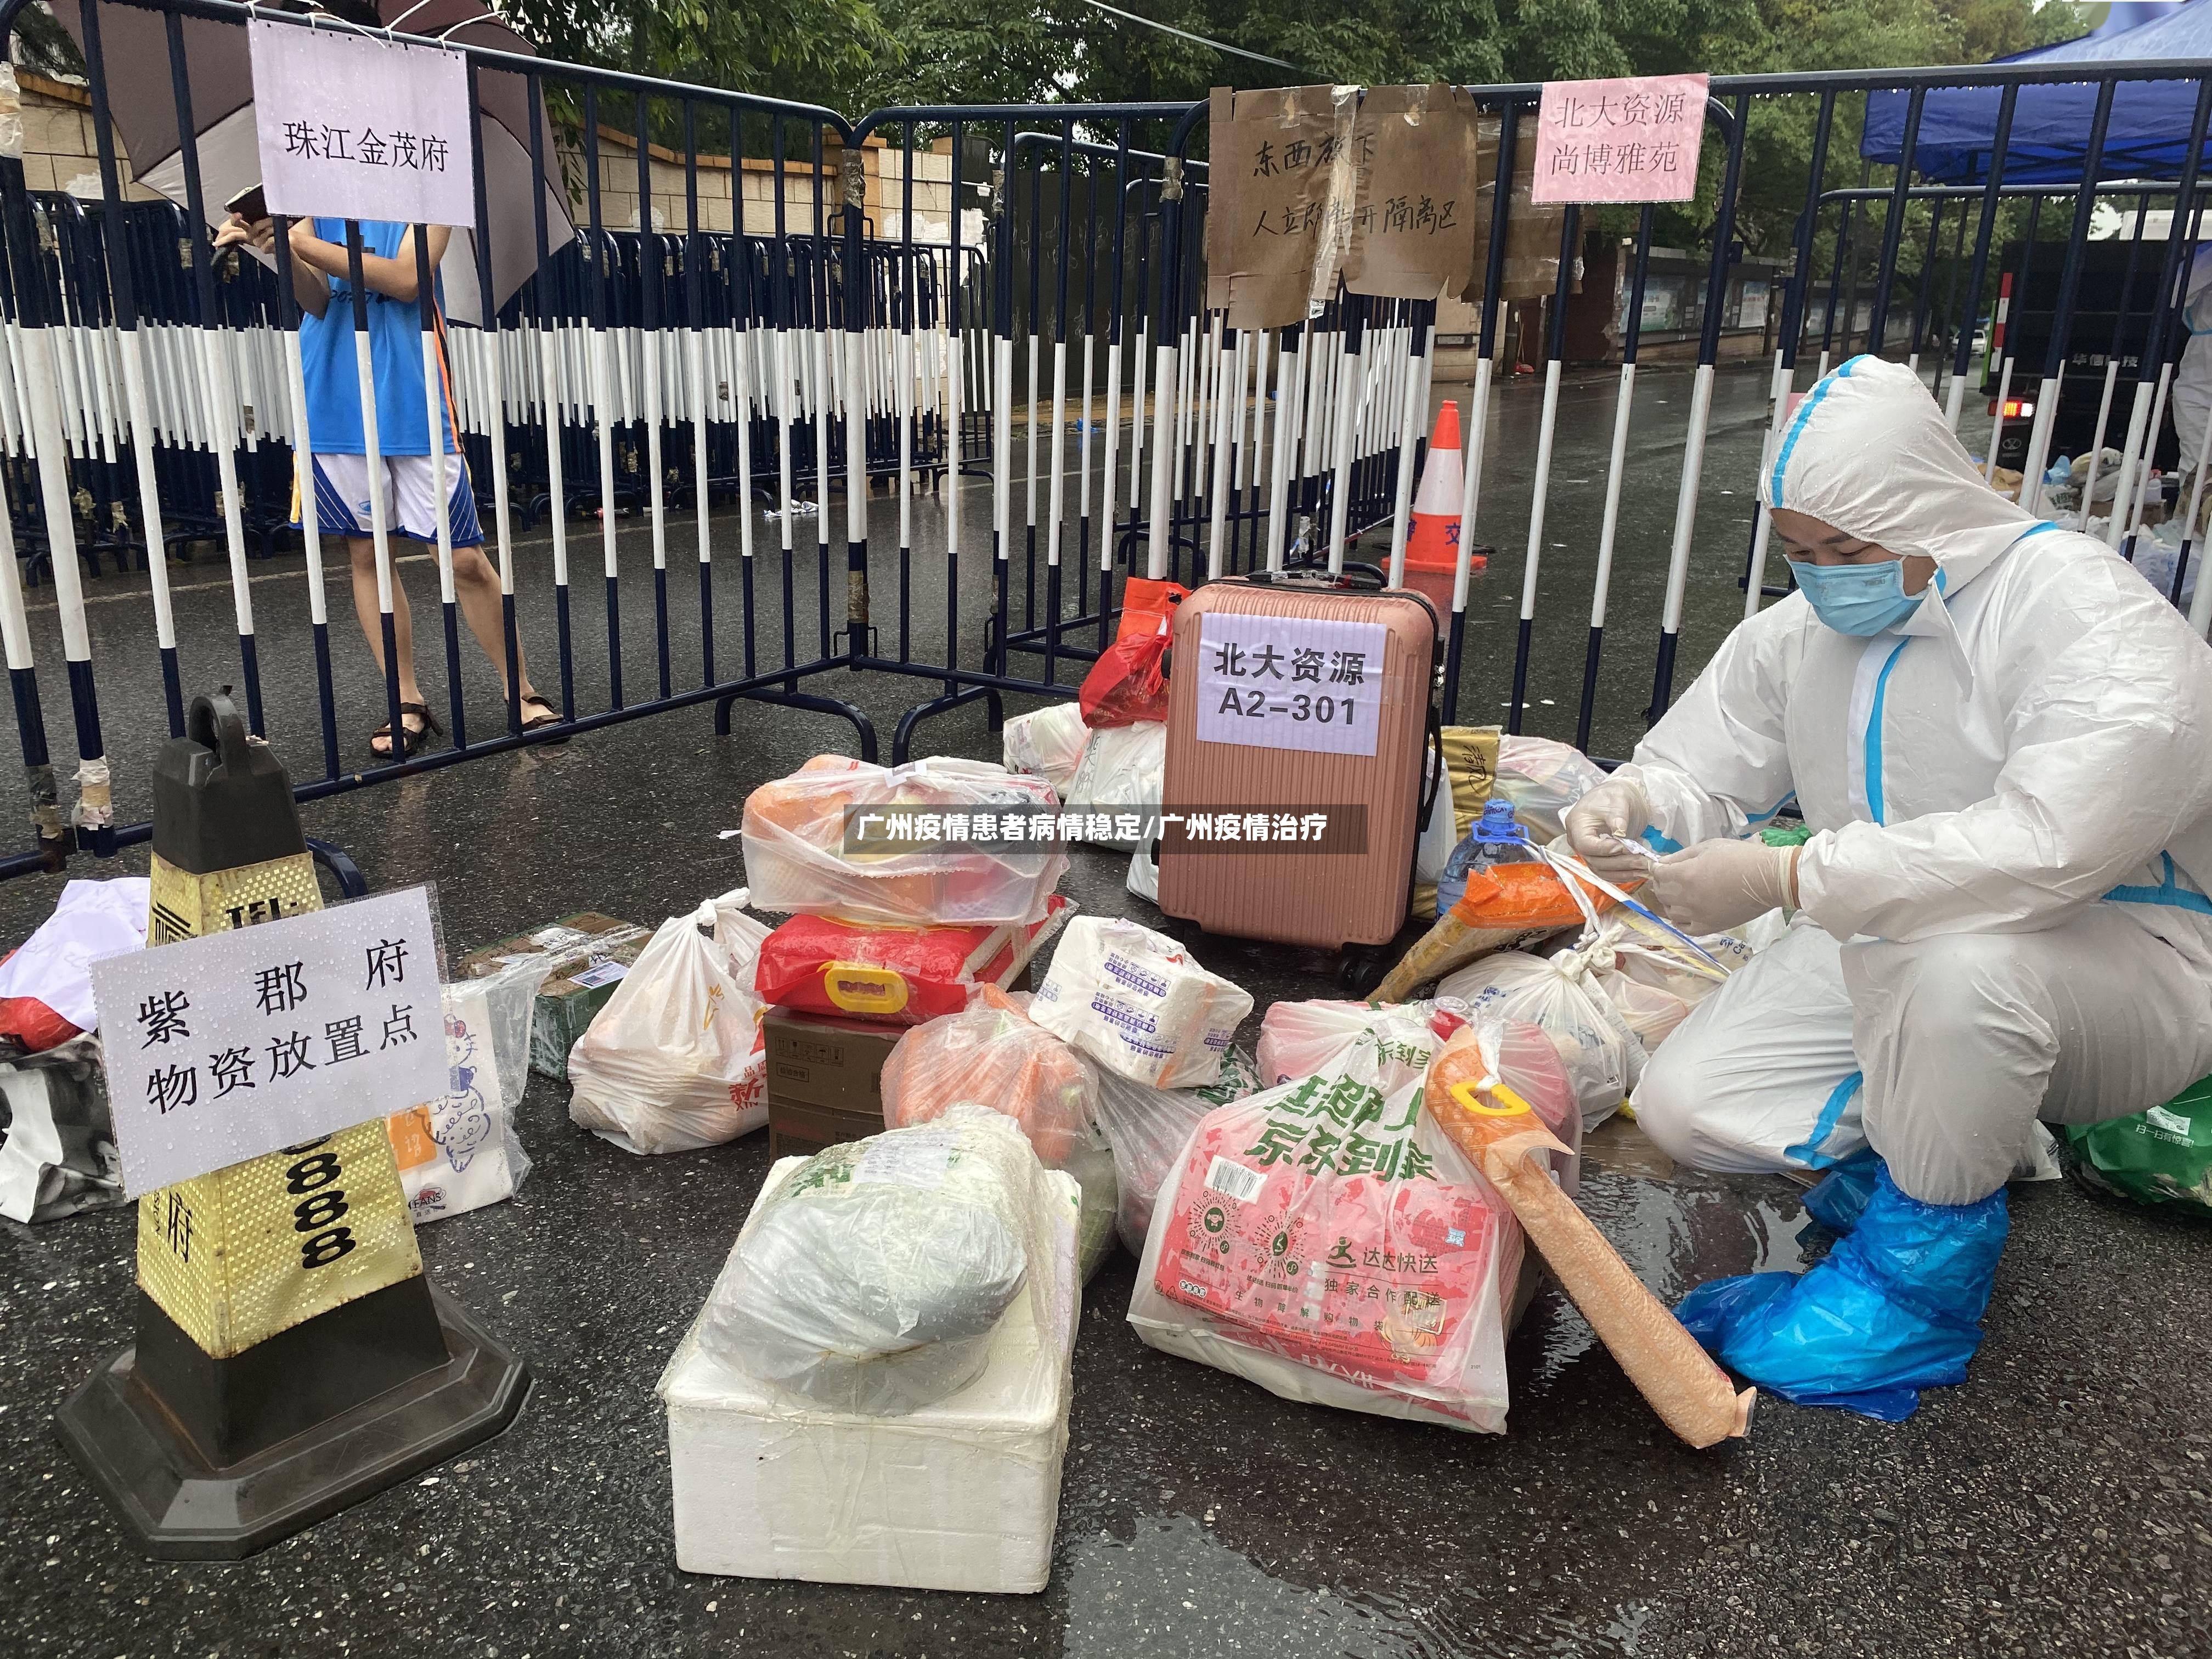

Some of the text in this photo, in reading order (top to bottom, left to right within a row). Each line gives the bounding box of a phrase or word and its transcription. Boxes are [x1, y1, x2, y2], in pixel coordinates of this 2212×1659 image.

[1554, 92, 1686, 128] 北大资源
[282, 120, 449, 172] 珠江金茂府
[1551, 140, 1680, 176] 尚博雅苑
[1214, 642, 1366, 686] 北大资源
[1218, 687, 1355, 725] A2-301
[137, 938, 408, 1049] 紫郡府
[146, 1005, 417, 1115] 物资放置点
[729, 1074, 767, 1102] 新
[281, 1134, 356, 1269] 888
[1363, 1246, 1438, 1274] 达达快送
[1324, 1278, 1441, 1307] 独家合作配送
